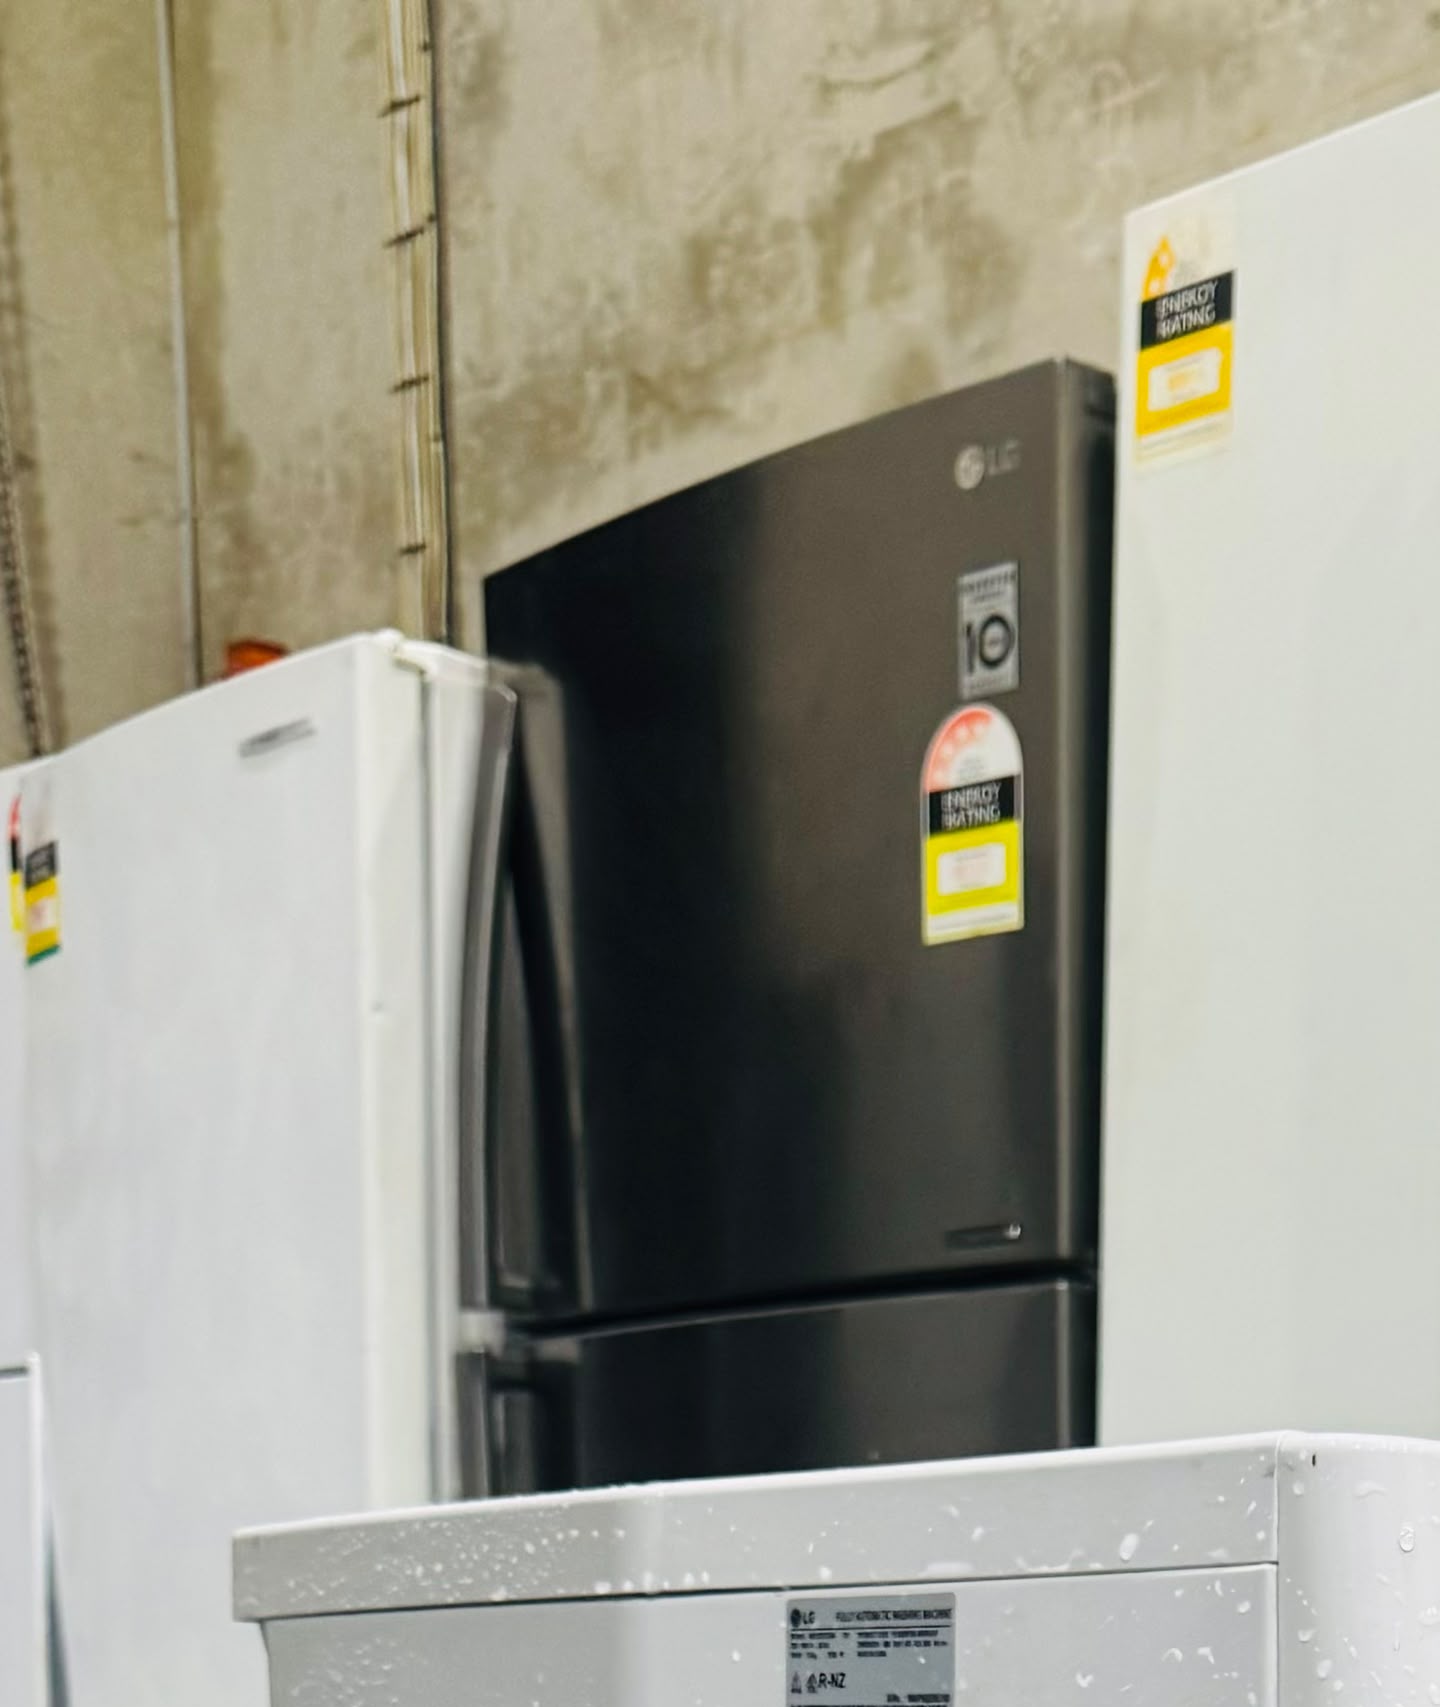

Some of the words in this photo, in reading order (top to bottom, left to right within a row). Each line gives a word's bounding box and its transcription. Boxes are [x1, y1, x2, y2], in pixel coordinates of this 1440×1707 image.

[1156, 280, 1218, 319] ENERGY
[1156, 303, 1216, 338] RATING
[941, 783, 1001, 808] ENERGY
[942, 806, 1000, 831] RATING
